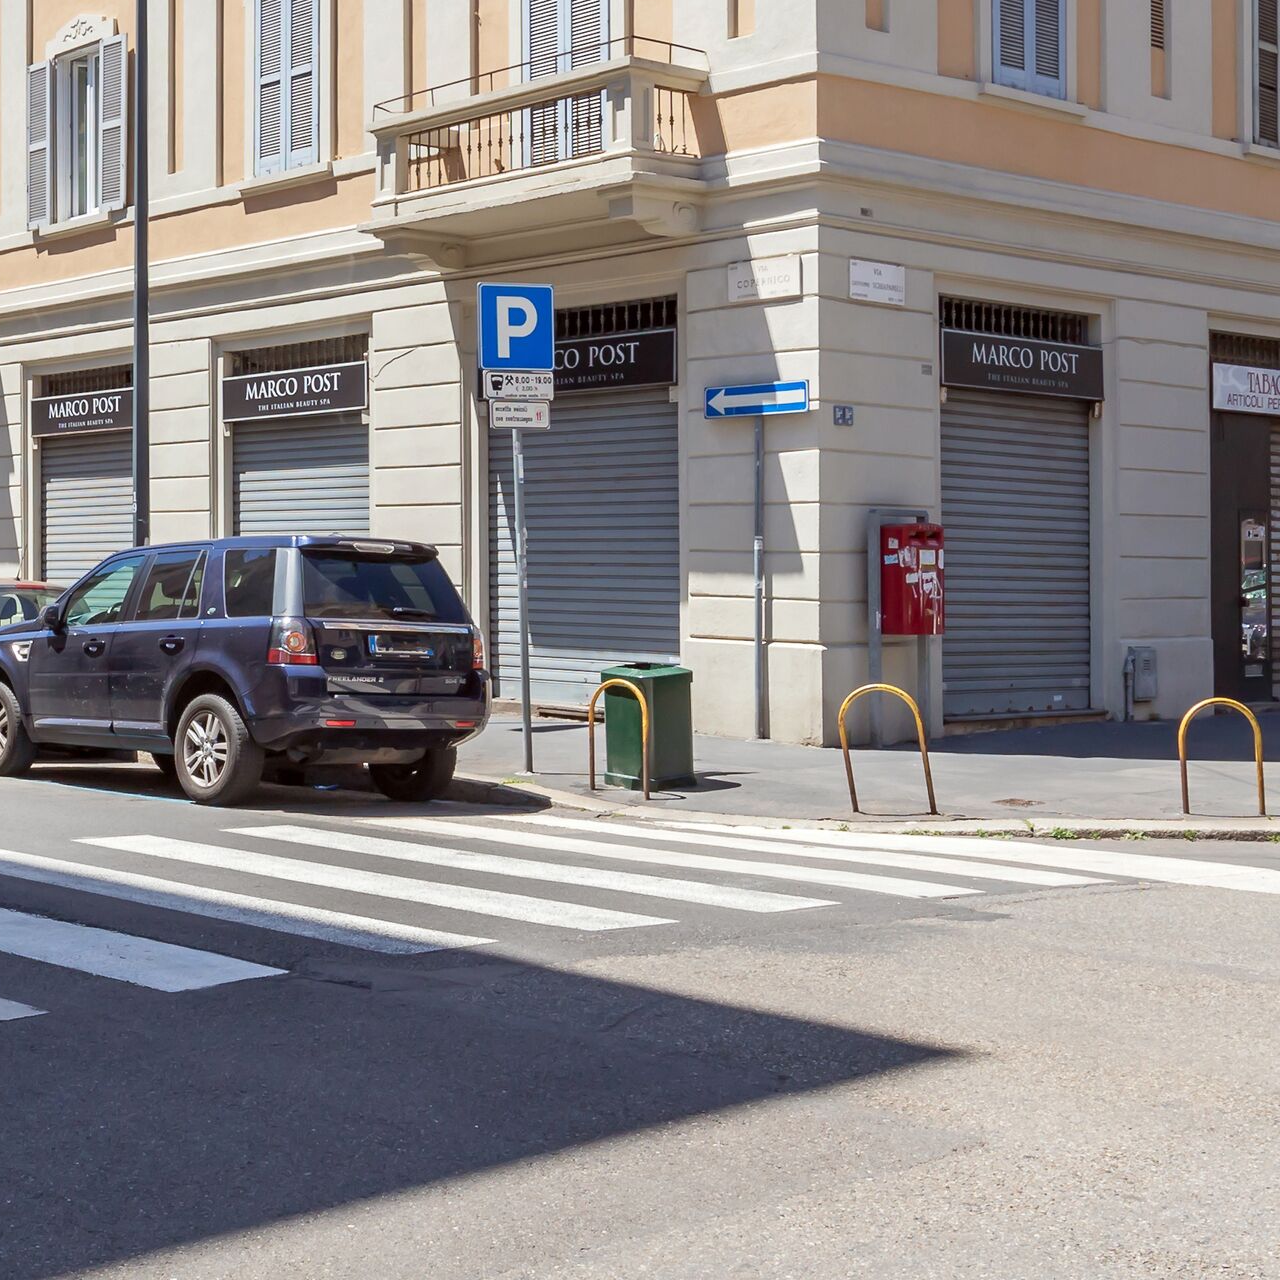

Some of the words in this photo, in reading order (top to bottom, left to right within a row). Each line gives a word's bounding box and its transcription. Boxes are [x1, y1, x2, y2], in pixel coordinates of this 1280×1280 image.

[496, 295, 538, 359] P
[554, 348, 579, 370] CO
[589, 341, 640, 367] POST
[972, 342, 1033, 369] MARCO
[1040, 349, 1079, 374] POST
[245, 377, 298, 400] MARCO
[303, 372, 341, 394] POST
[48, 399, 88, 419] MARCO
[92, 395, 122, 414] POST
[271, 402, 294, 410] ITALIAN
[296, 400, 318, 408] BEAUTY
[1227, 393, 1264, 409] ARTICOLI
